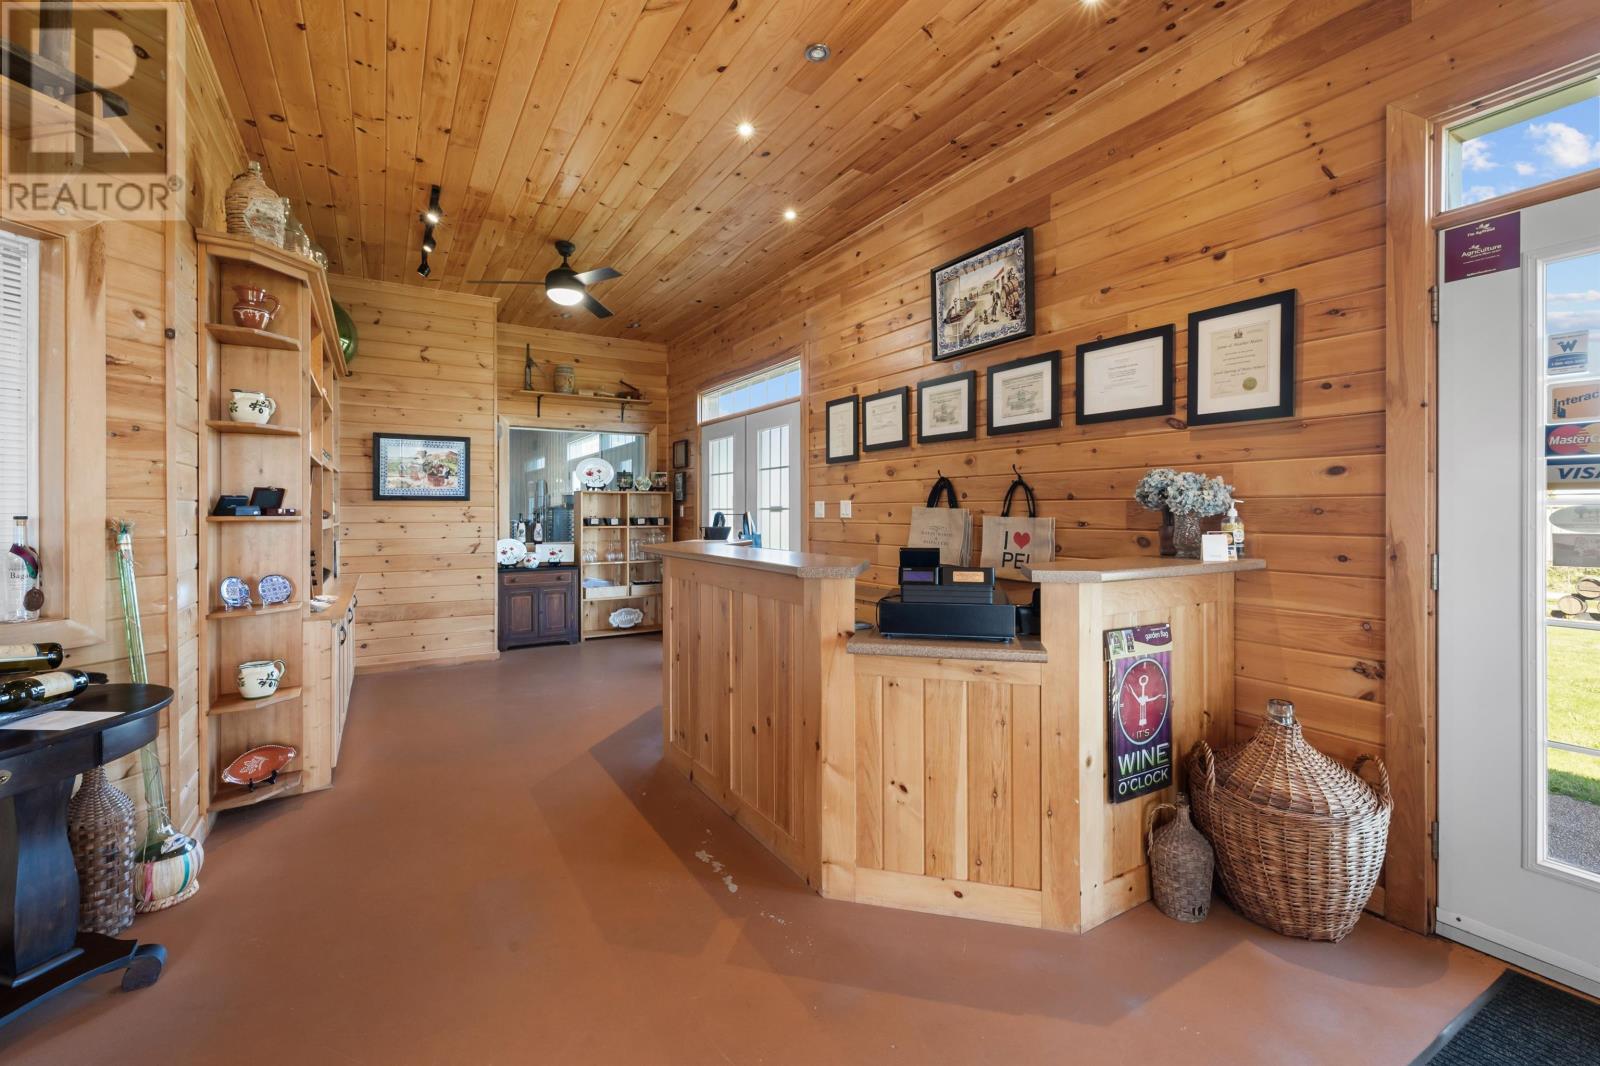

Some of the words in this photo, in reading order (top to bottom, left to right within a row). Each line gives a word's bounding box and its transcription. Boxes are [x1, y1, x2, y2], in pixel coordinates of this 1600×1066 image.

[1461, 243, 1502, 258] Agriculture
[1003, 530, 1009, 550] I
[1136, 728, 1150, 739] IT'S
[1117, 742, 1169, 776] WINE
[1118, 767, 1169, 795] O'CLOCK
